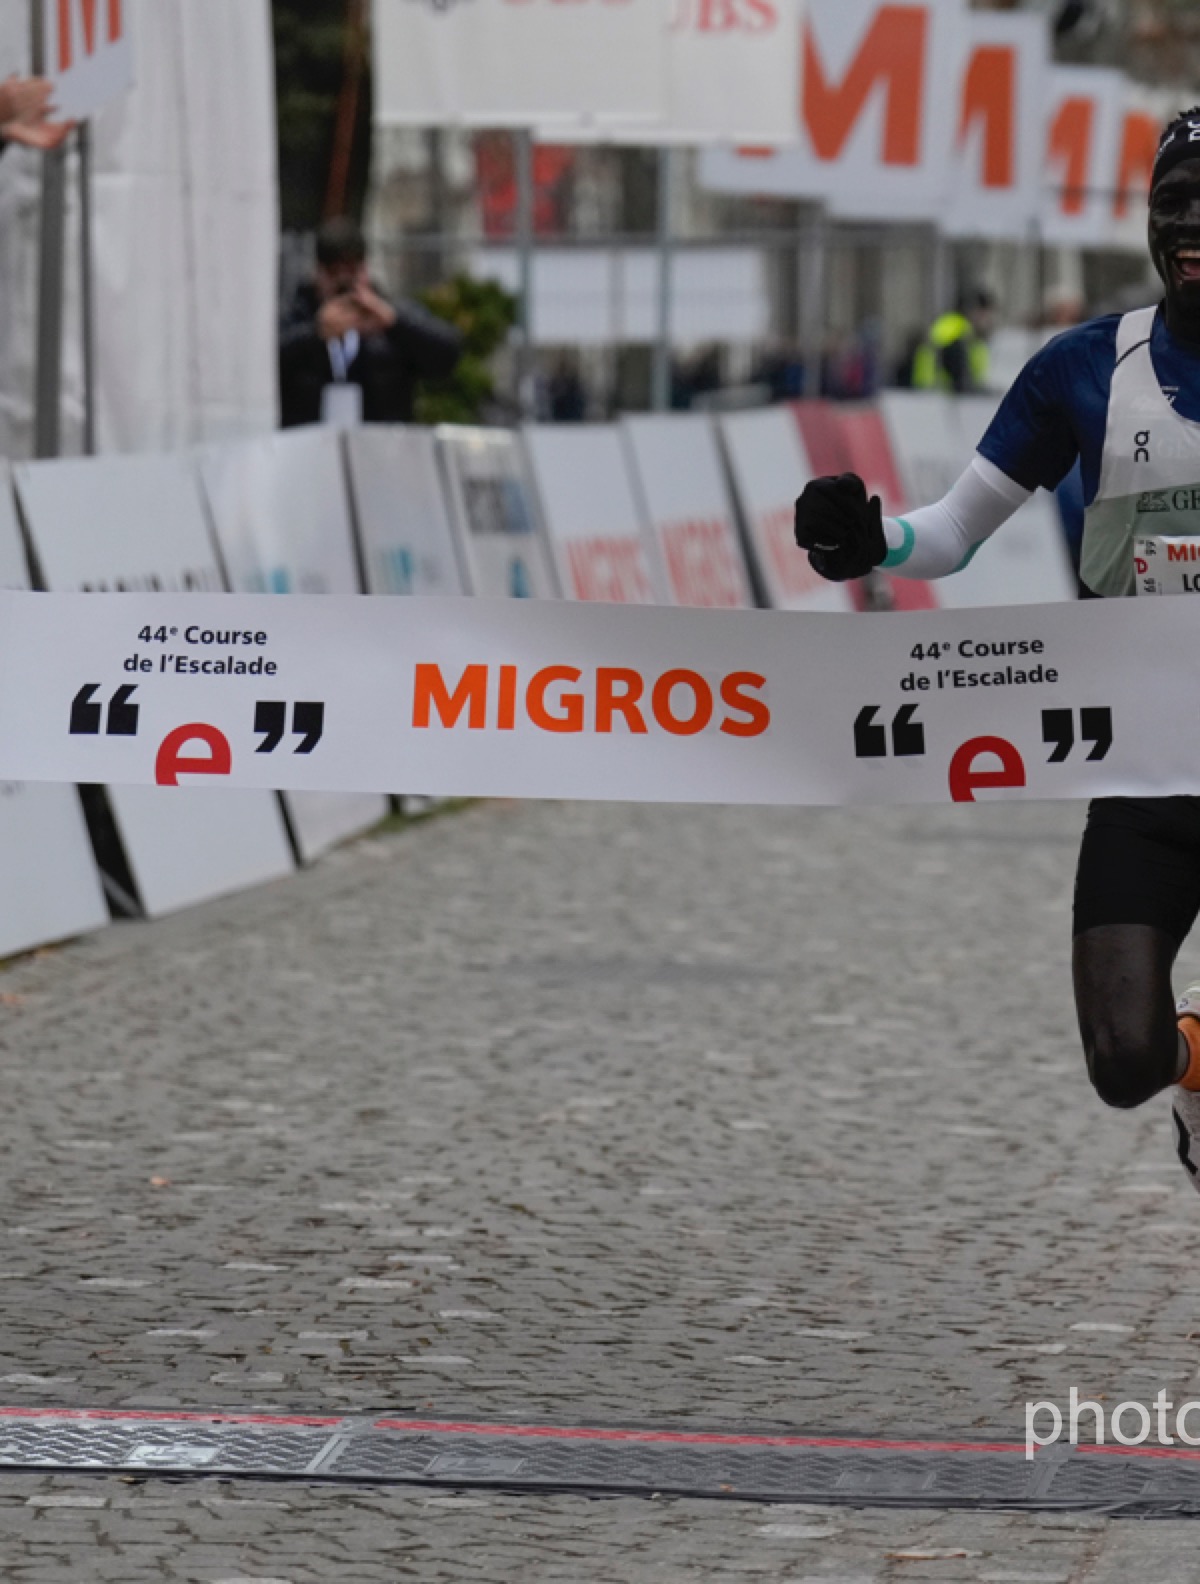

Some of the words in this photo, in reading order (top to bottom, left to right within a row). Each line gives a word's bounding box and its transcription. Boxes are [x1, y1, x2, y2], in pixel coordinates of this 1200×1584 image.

[184, 625, 268, 646] Course
[957, 639, 1045, 659] Course
[123, 653, 153, 673] de
[159, 654, 278, 676] l’Escalade
[899, 669, 931, 691] de
[937, 664, 1059, 689] l’Escalade
[411, 662, 771, 739] MIGROS
